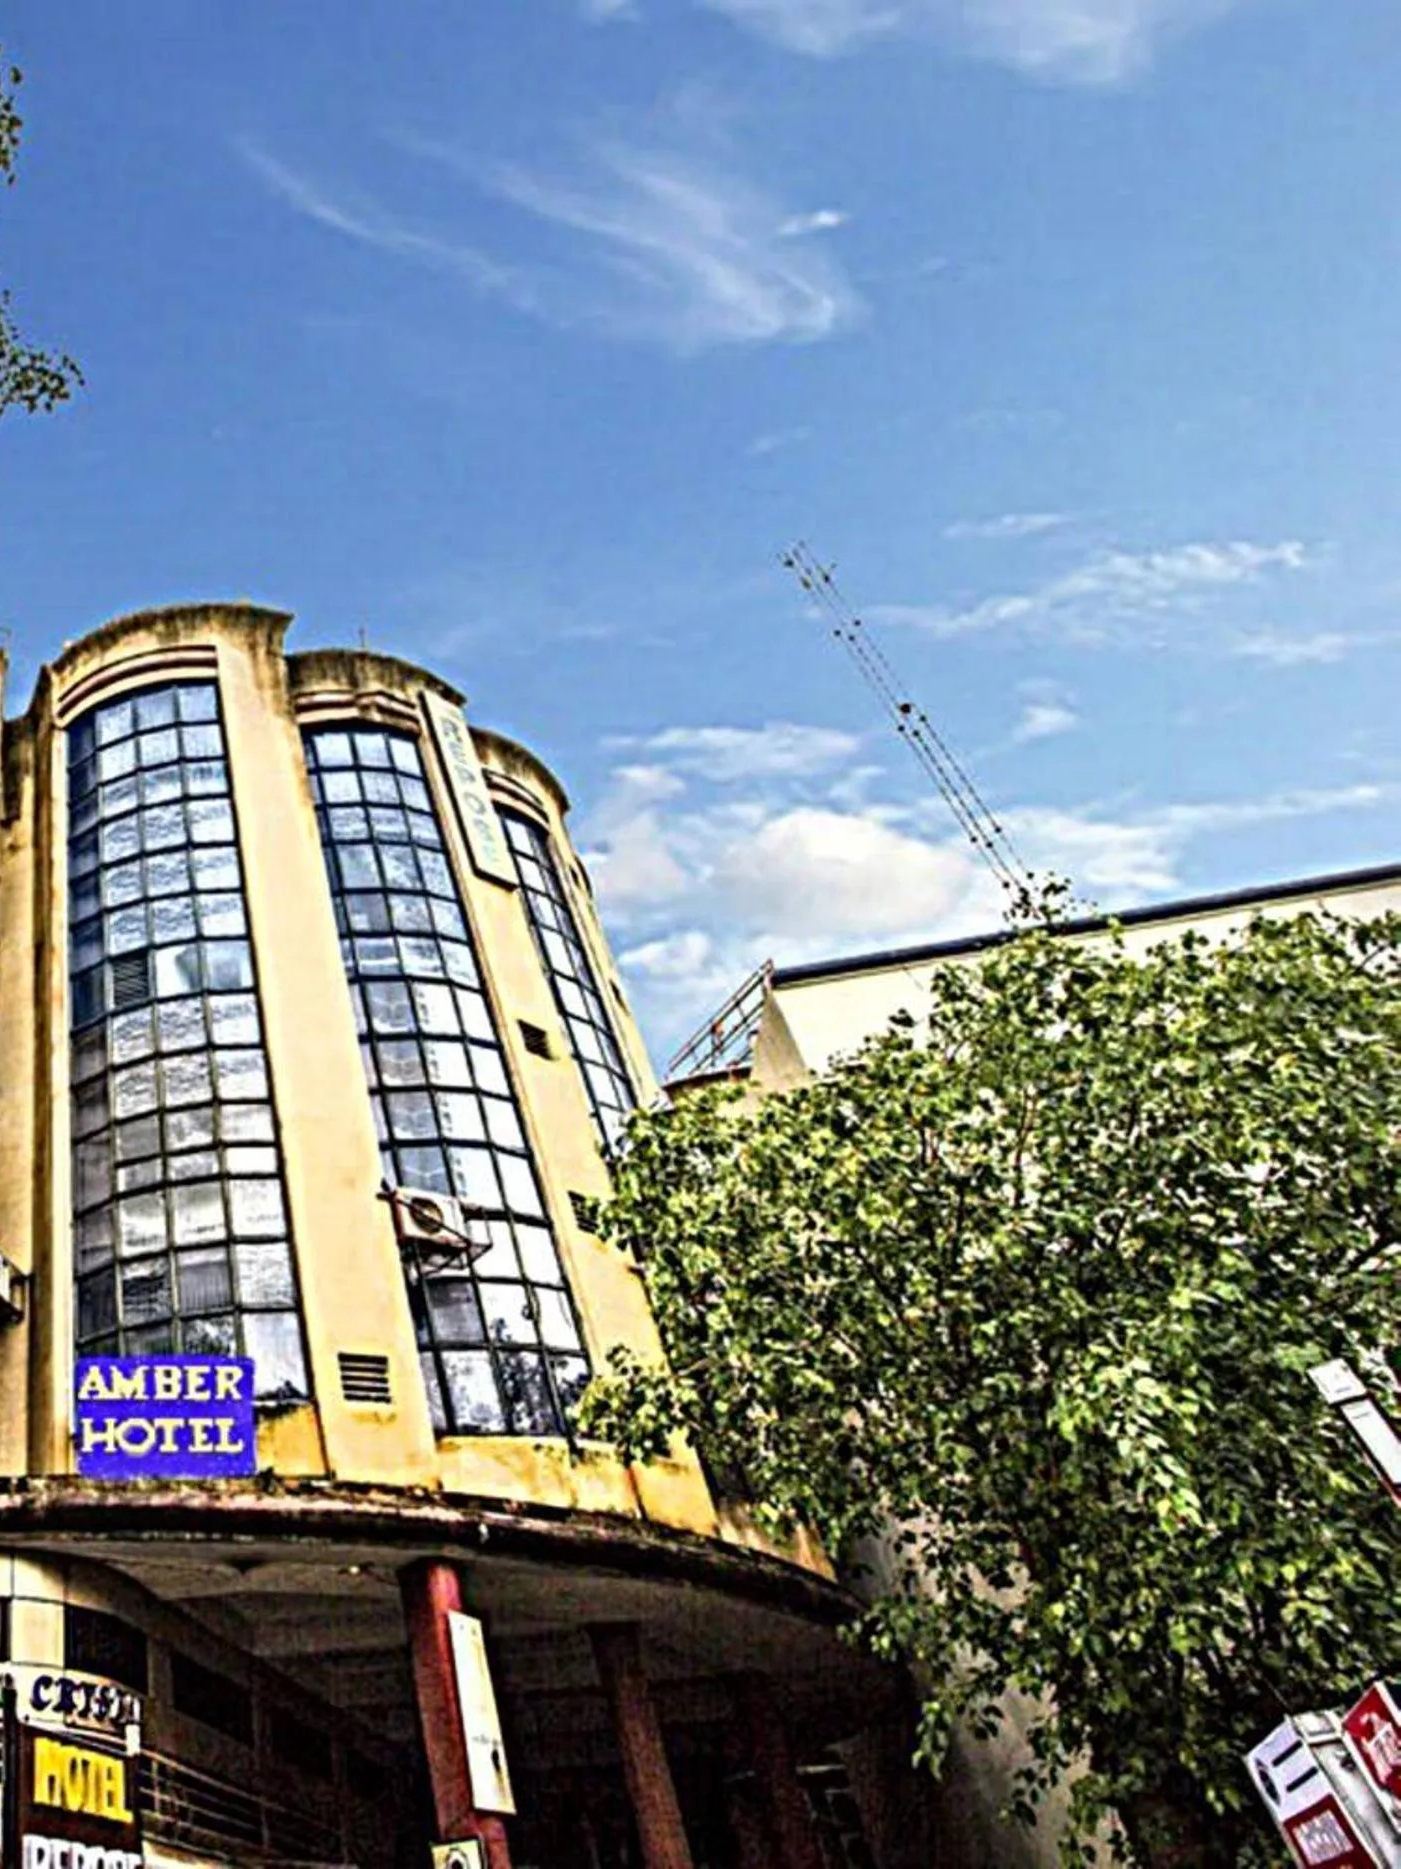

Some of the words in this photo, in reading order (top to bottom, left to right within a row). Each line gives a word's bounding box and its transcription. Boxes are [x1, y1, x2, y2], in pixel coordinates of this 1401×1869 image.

[78, 1365, 244, 1400] AMBER
[81, 1418, 244, 1455] HOTEL
[34, 1737, 134, 1823] HOTEL
